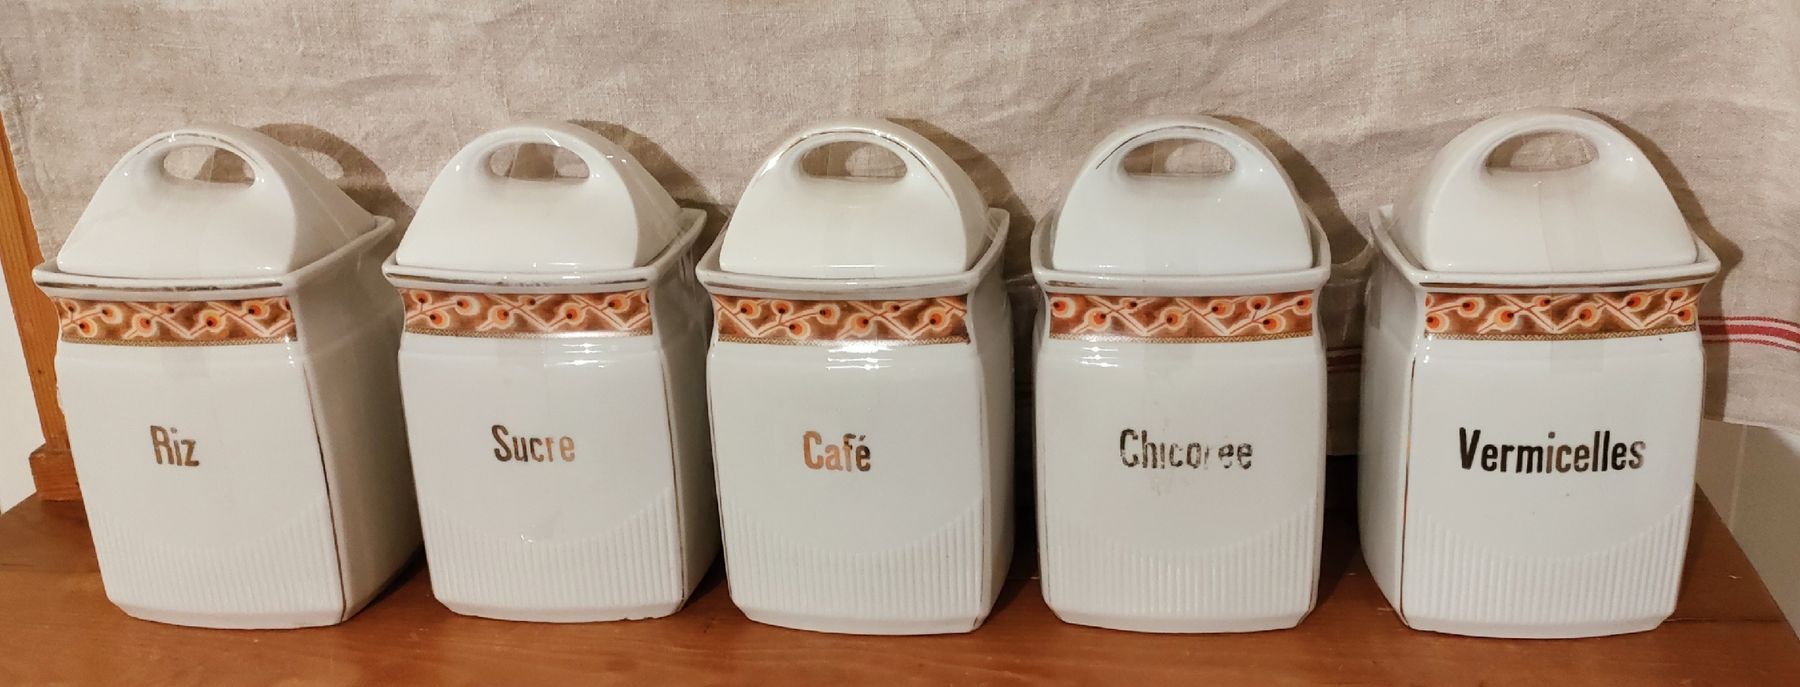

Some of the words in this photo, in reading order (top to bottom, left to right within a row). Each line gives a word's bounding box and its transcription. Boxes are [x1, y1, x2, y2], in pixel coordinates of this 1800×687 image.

[150, 425, 200, 467] Riz
[491, 424, 576, 463] Sucre
[803, 430, 871, 472] Café
[1459, 426, 1647, 474] Vermicelles
